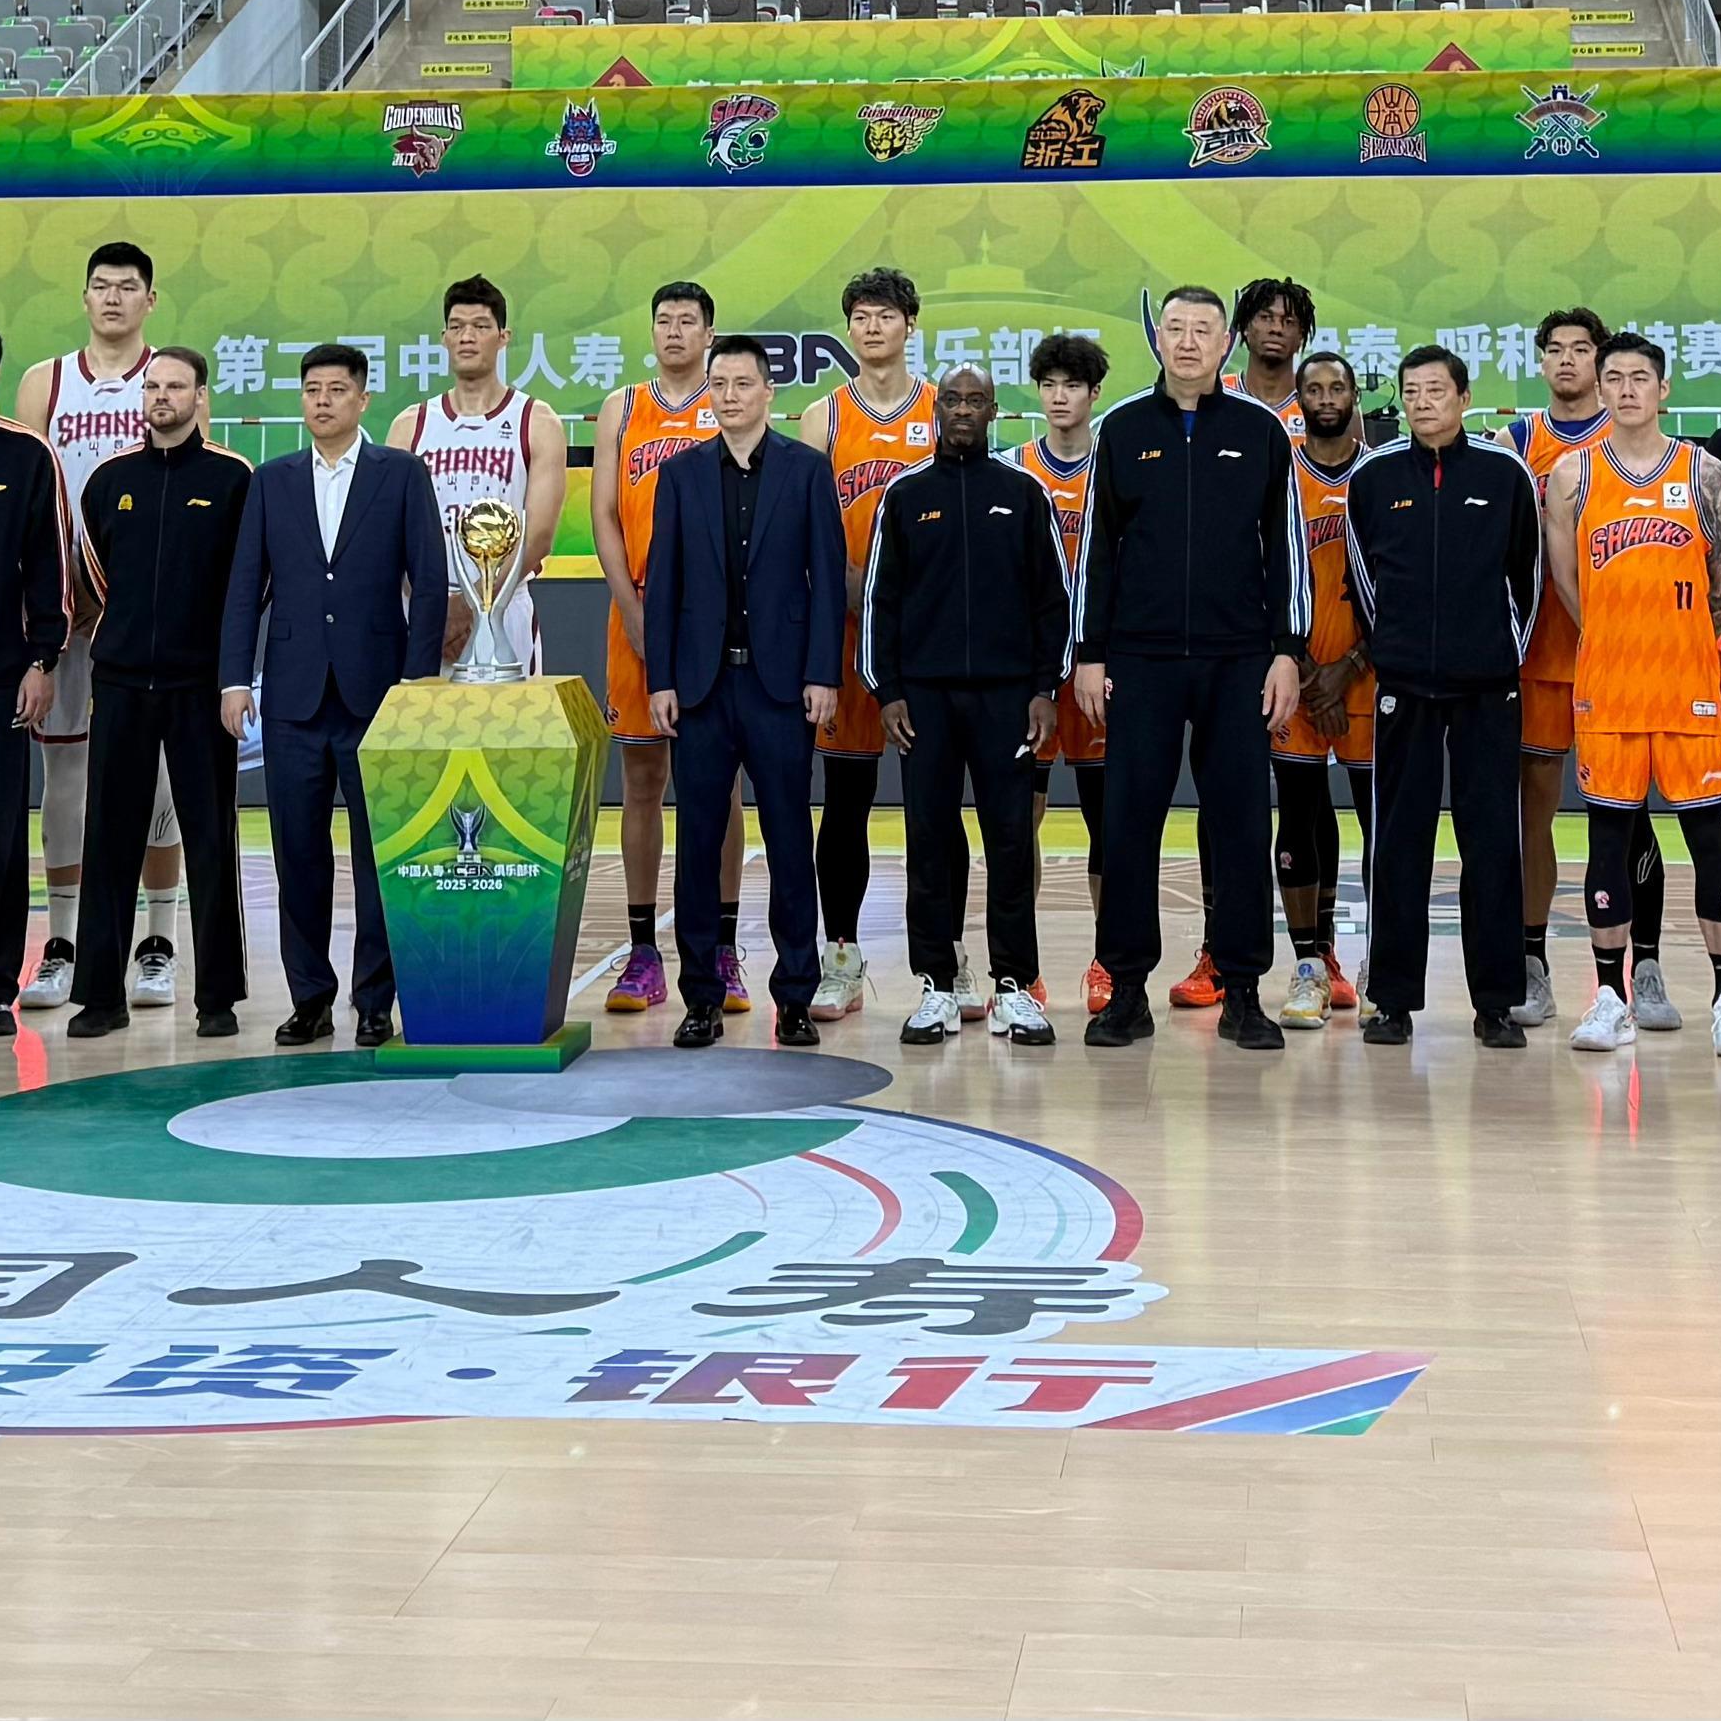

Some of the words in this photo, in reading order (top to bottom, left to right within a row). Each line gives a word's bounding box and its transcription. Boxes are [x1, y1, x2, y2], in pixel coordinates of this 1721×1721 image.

[383, 104, 463, 132] GOLDENBULLS
[1024, 141, 1100, 167] 浙江
[1359, 131, 1427, 163] SHANXI
[57, 408, 149, 447] SHANX
[1591, 517, 1694, 570] SHARKS
[1674, 580, 1694, 610] 11
